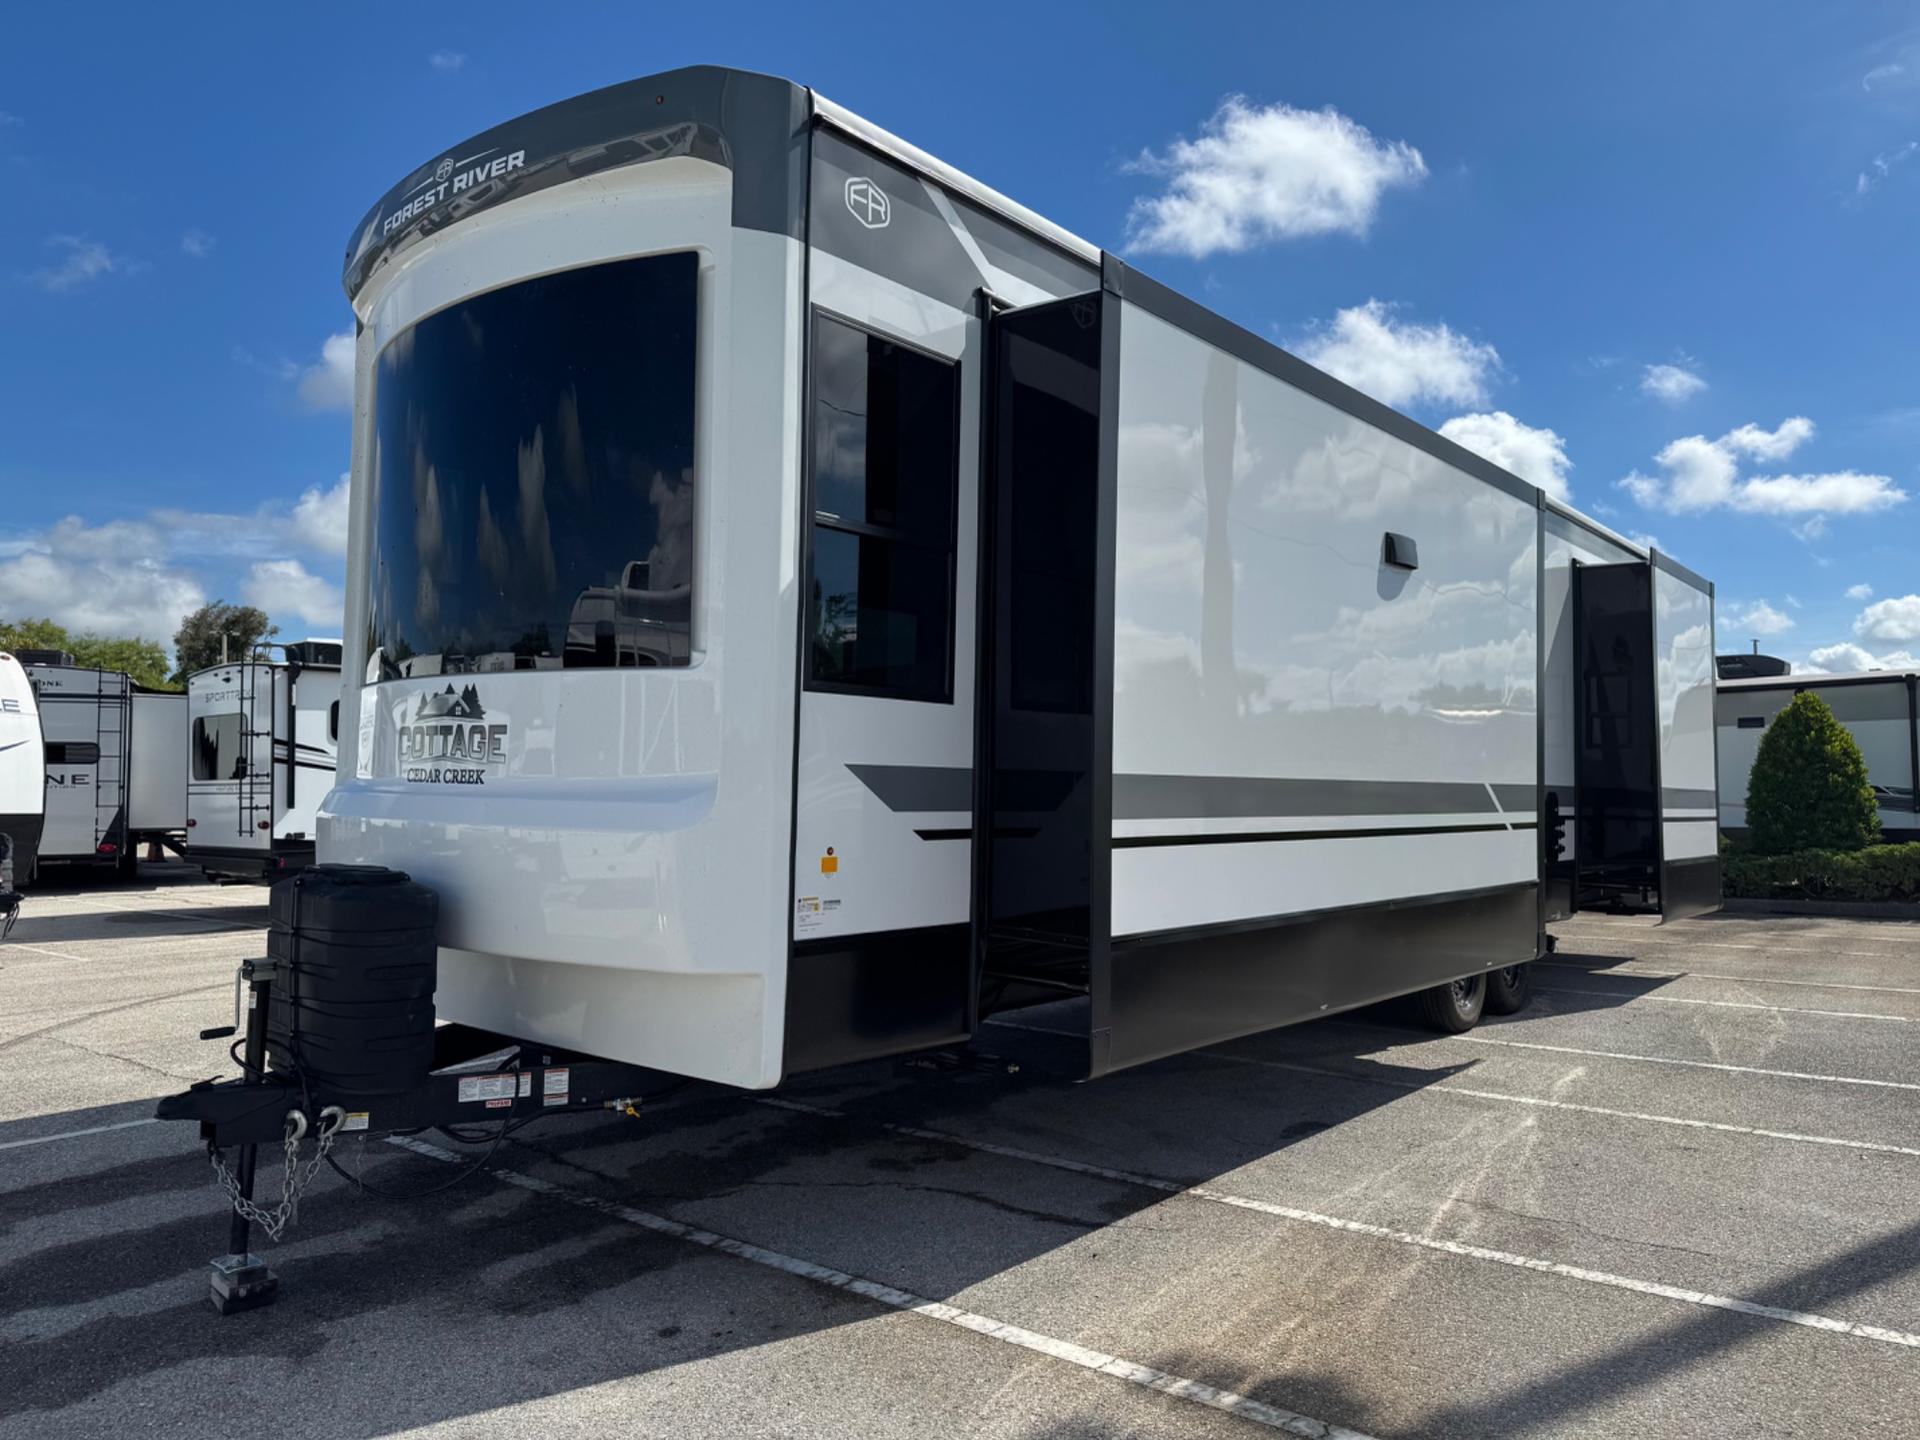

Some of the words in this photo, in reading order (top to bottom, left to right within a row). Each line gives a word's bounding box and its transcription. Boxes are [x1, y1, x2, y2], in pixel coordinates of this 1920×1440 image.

[383, 182, 450, 236] FOREST
[453, 150, 526, 193] RIVER
[0, 698, 21, 713] E
[398, 724, 508, 764] COTTAGE
[407, 768, 441, 783] CEDAR
[443, 768, 485, 784] CREEK
